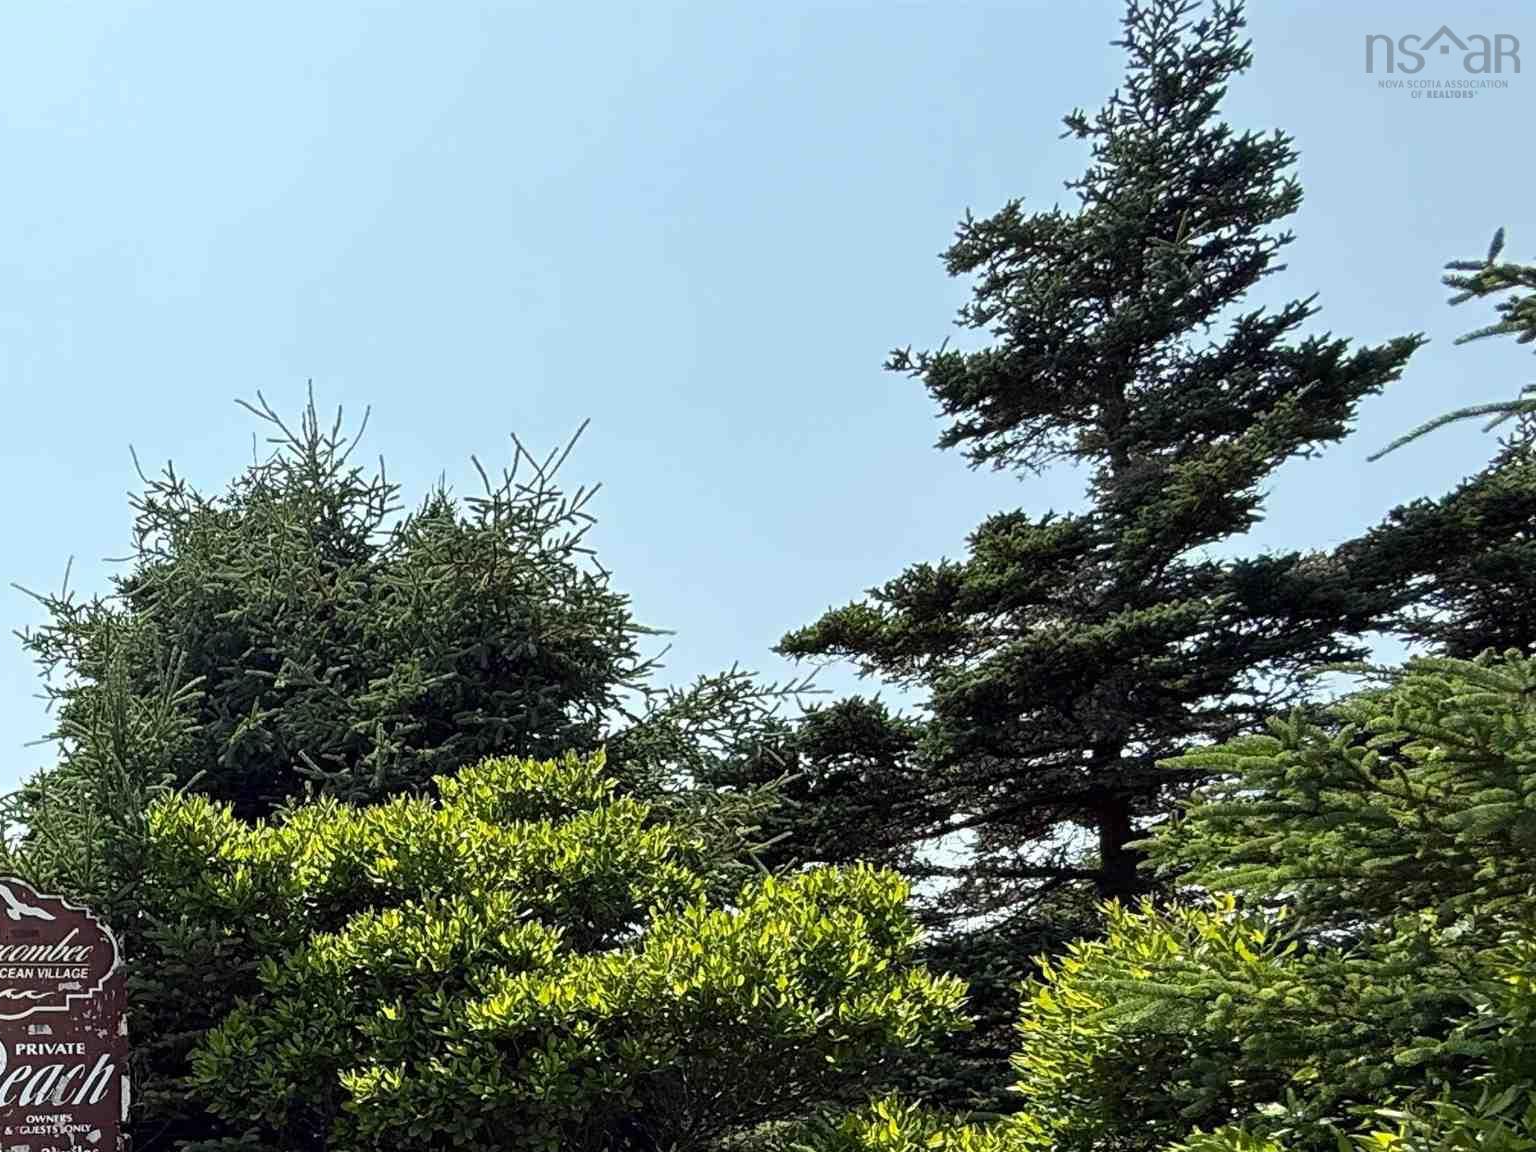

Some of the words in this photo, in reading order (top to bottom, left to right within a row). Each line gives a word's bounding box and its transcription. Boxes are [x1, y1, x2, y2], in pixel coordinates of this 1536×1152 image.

[37, 967, 89, 980] VILLAGE
[15, 1042, 86, 1056] PRIVATE
[4, 1127, 13, 1136] &
[20, 1124, 59, 1135] GUESTS
[65, 1123, 92, 1133] ONLY
